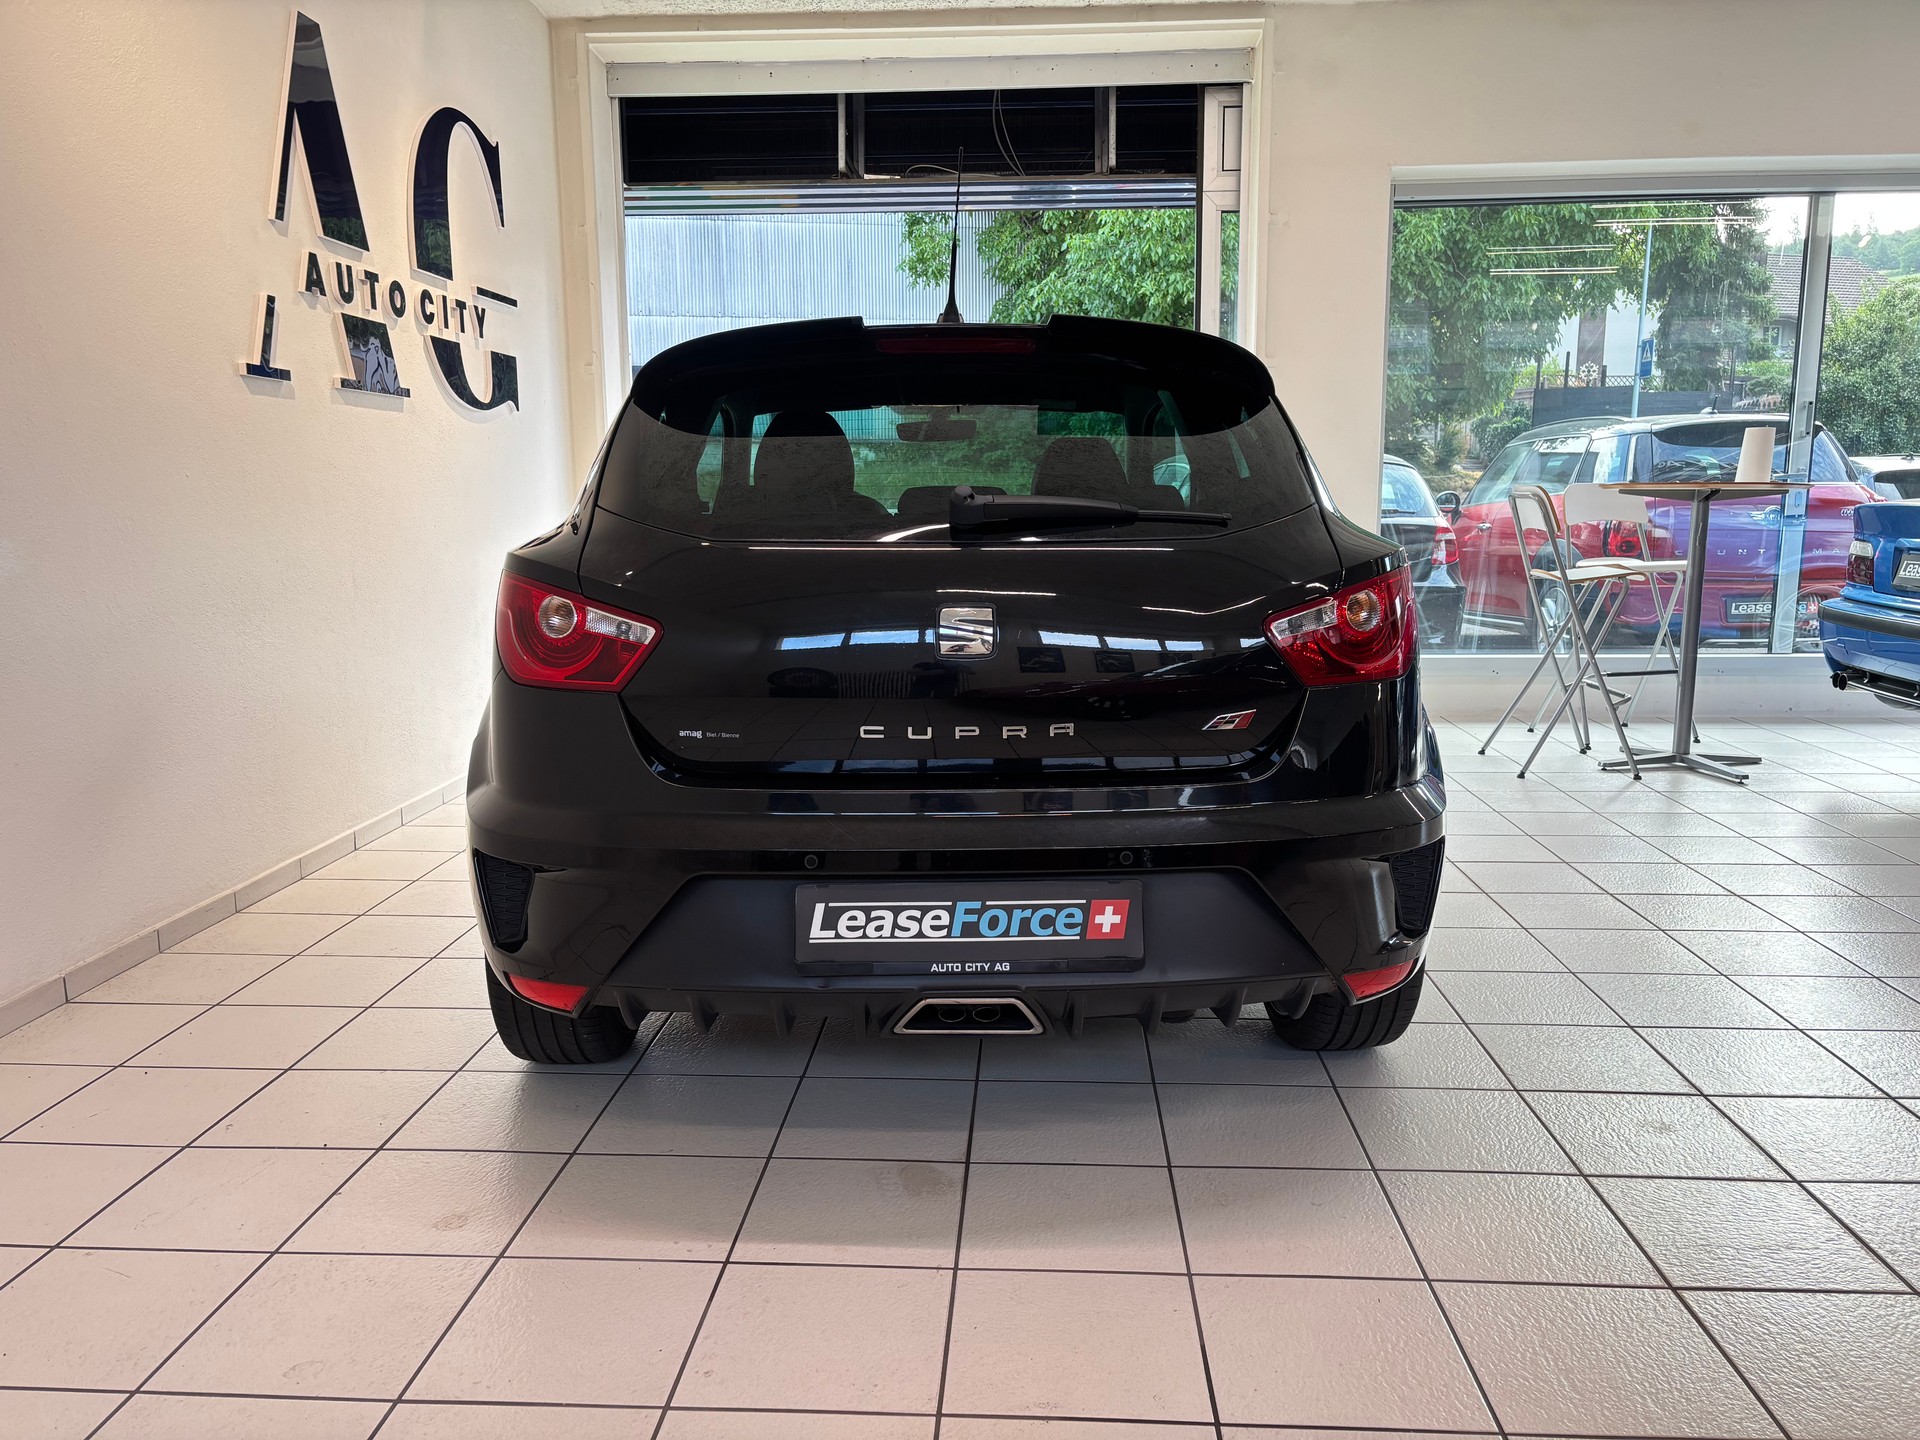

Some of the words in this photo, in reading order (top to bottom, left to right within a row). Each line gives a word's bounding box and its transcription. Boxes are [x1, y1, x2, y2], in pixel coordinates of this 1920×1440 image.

[300, 251, 406, 319] AUTO
[416, 288, 486, 340] CITY
[679, 730, 702, 738] amag
[859, 722, 1075, 740] CUPRA
[808, 901, 1084, 939] LeaseForce
[930, 963, 962, 972] AUTO
[965, 962, 990, 972] CITY
[994, 962, 1010, 971] AG
